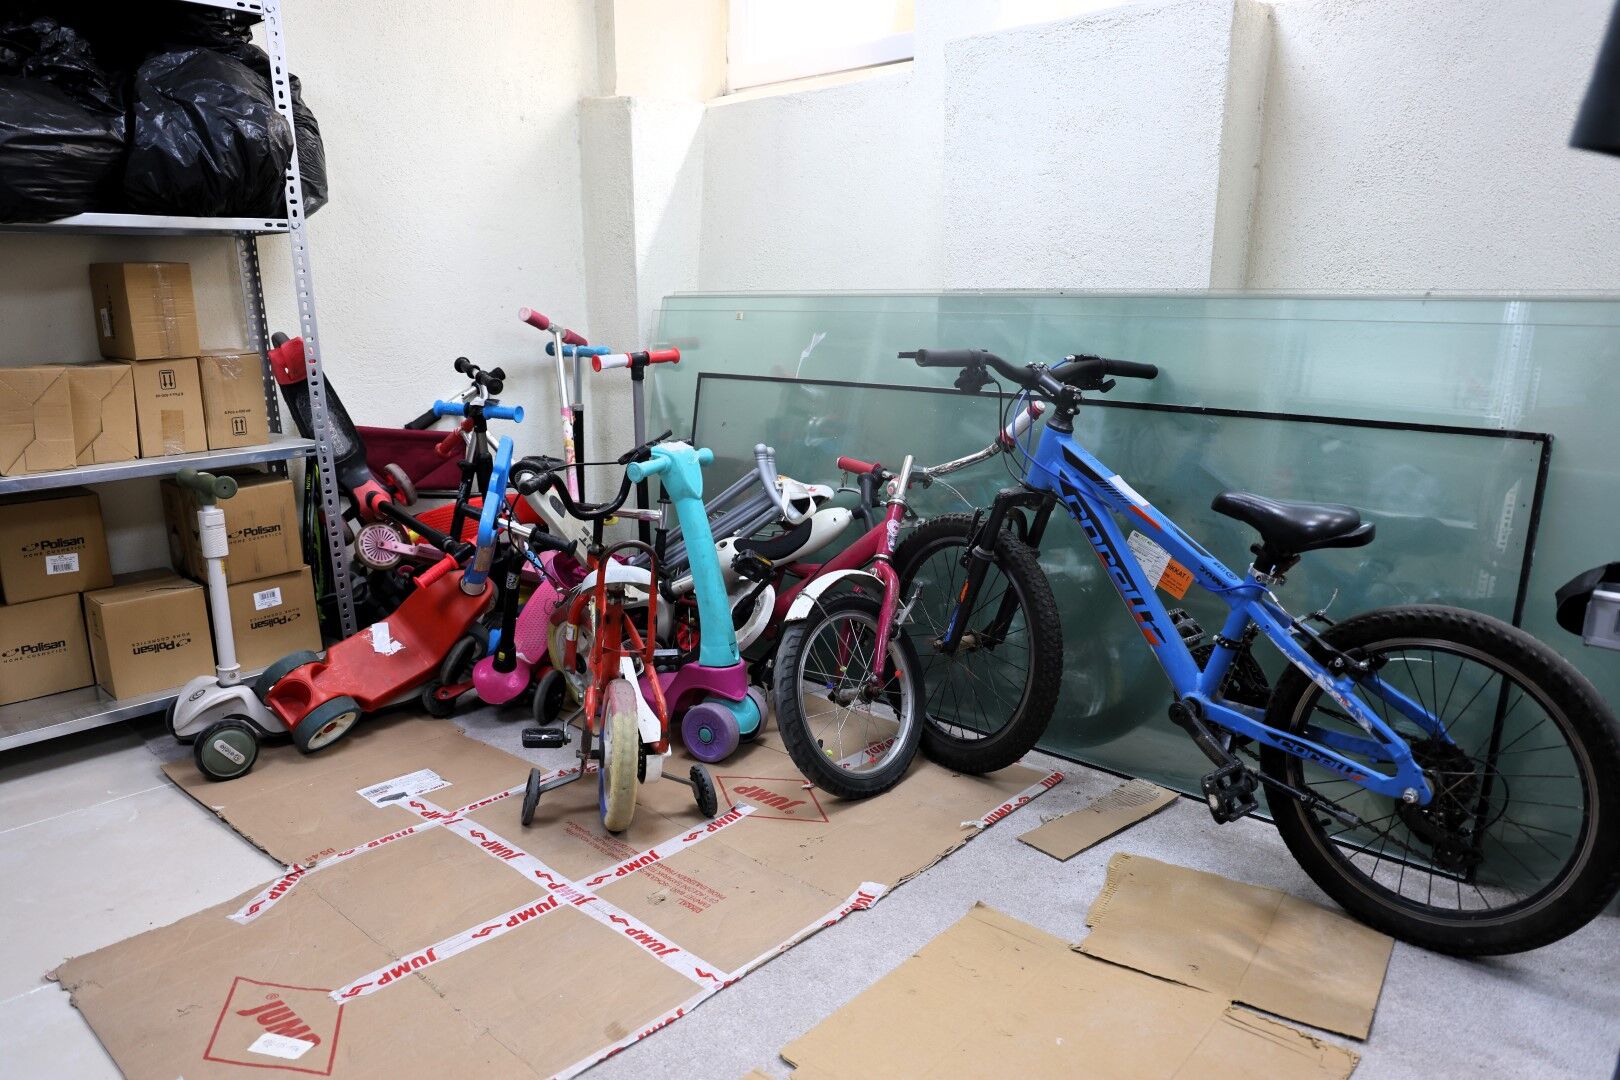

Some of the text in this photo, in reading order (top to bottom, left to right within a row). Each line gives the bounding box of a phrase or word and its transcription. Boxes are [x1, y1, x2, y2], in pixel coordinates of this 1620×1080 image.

[40, 536, 85, 550] Polisan
[244, 524, 281, 537] Polisan
[250, 616, 287, 630] Polisan
[21, 640, 66, 655] Polisan
[133, 641, 175, 655] Polisan
[733, 785, 806, 811] JUMP
[706, 806, 743, 833] JUMP
[480, 840, 526, 861] JUMP
[615, 849, 662, 877] JUMP
[506, 895, 559, 927] JUMP
[625, 928, 681, 956] JUMP
[377, 947, 437, 985] JUMP
[236, 1000, 322, 1047] JUMP
